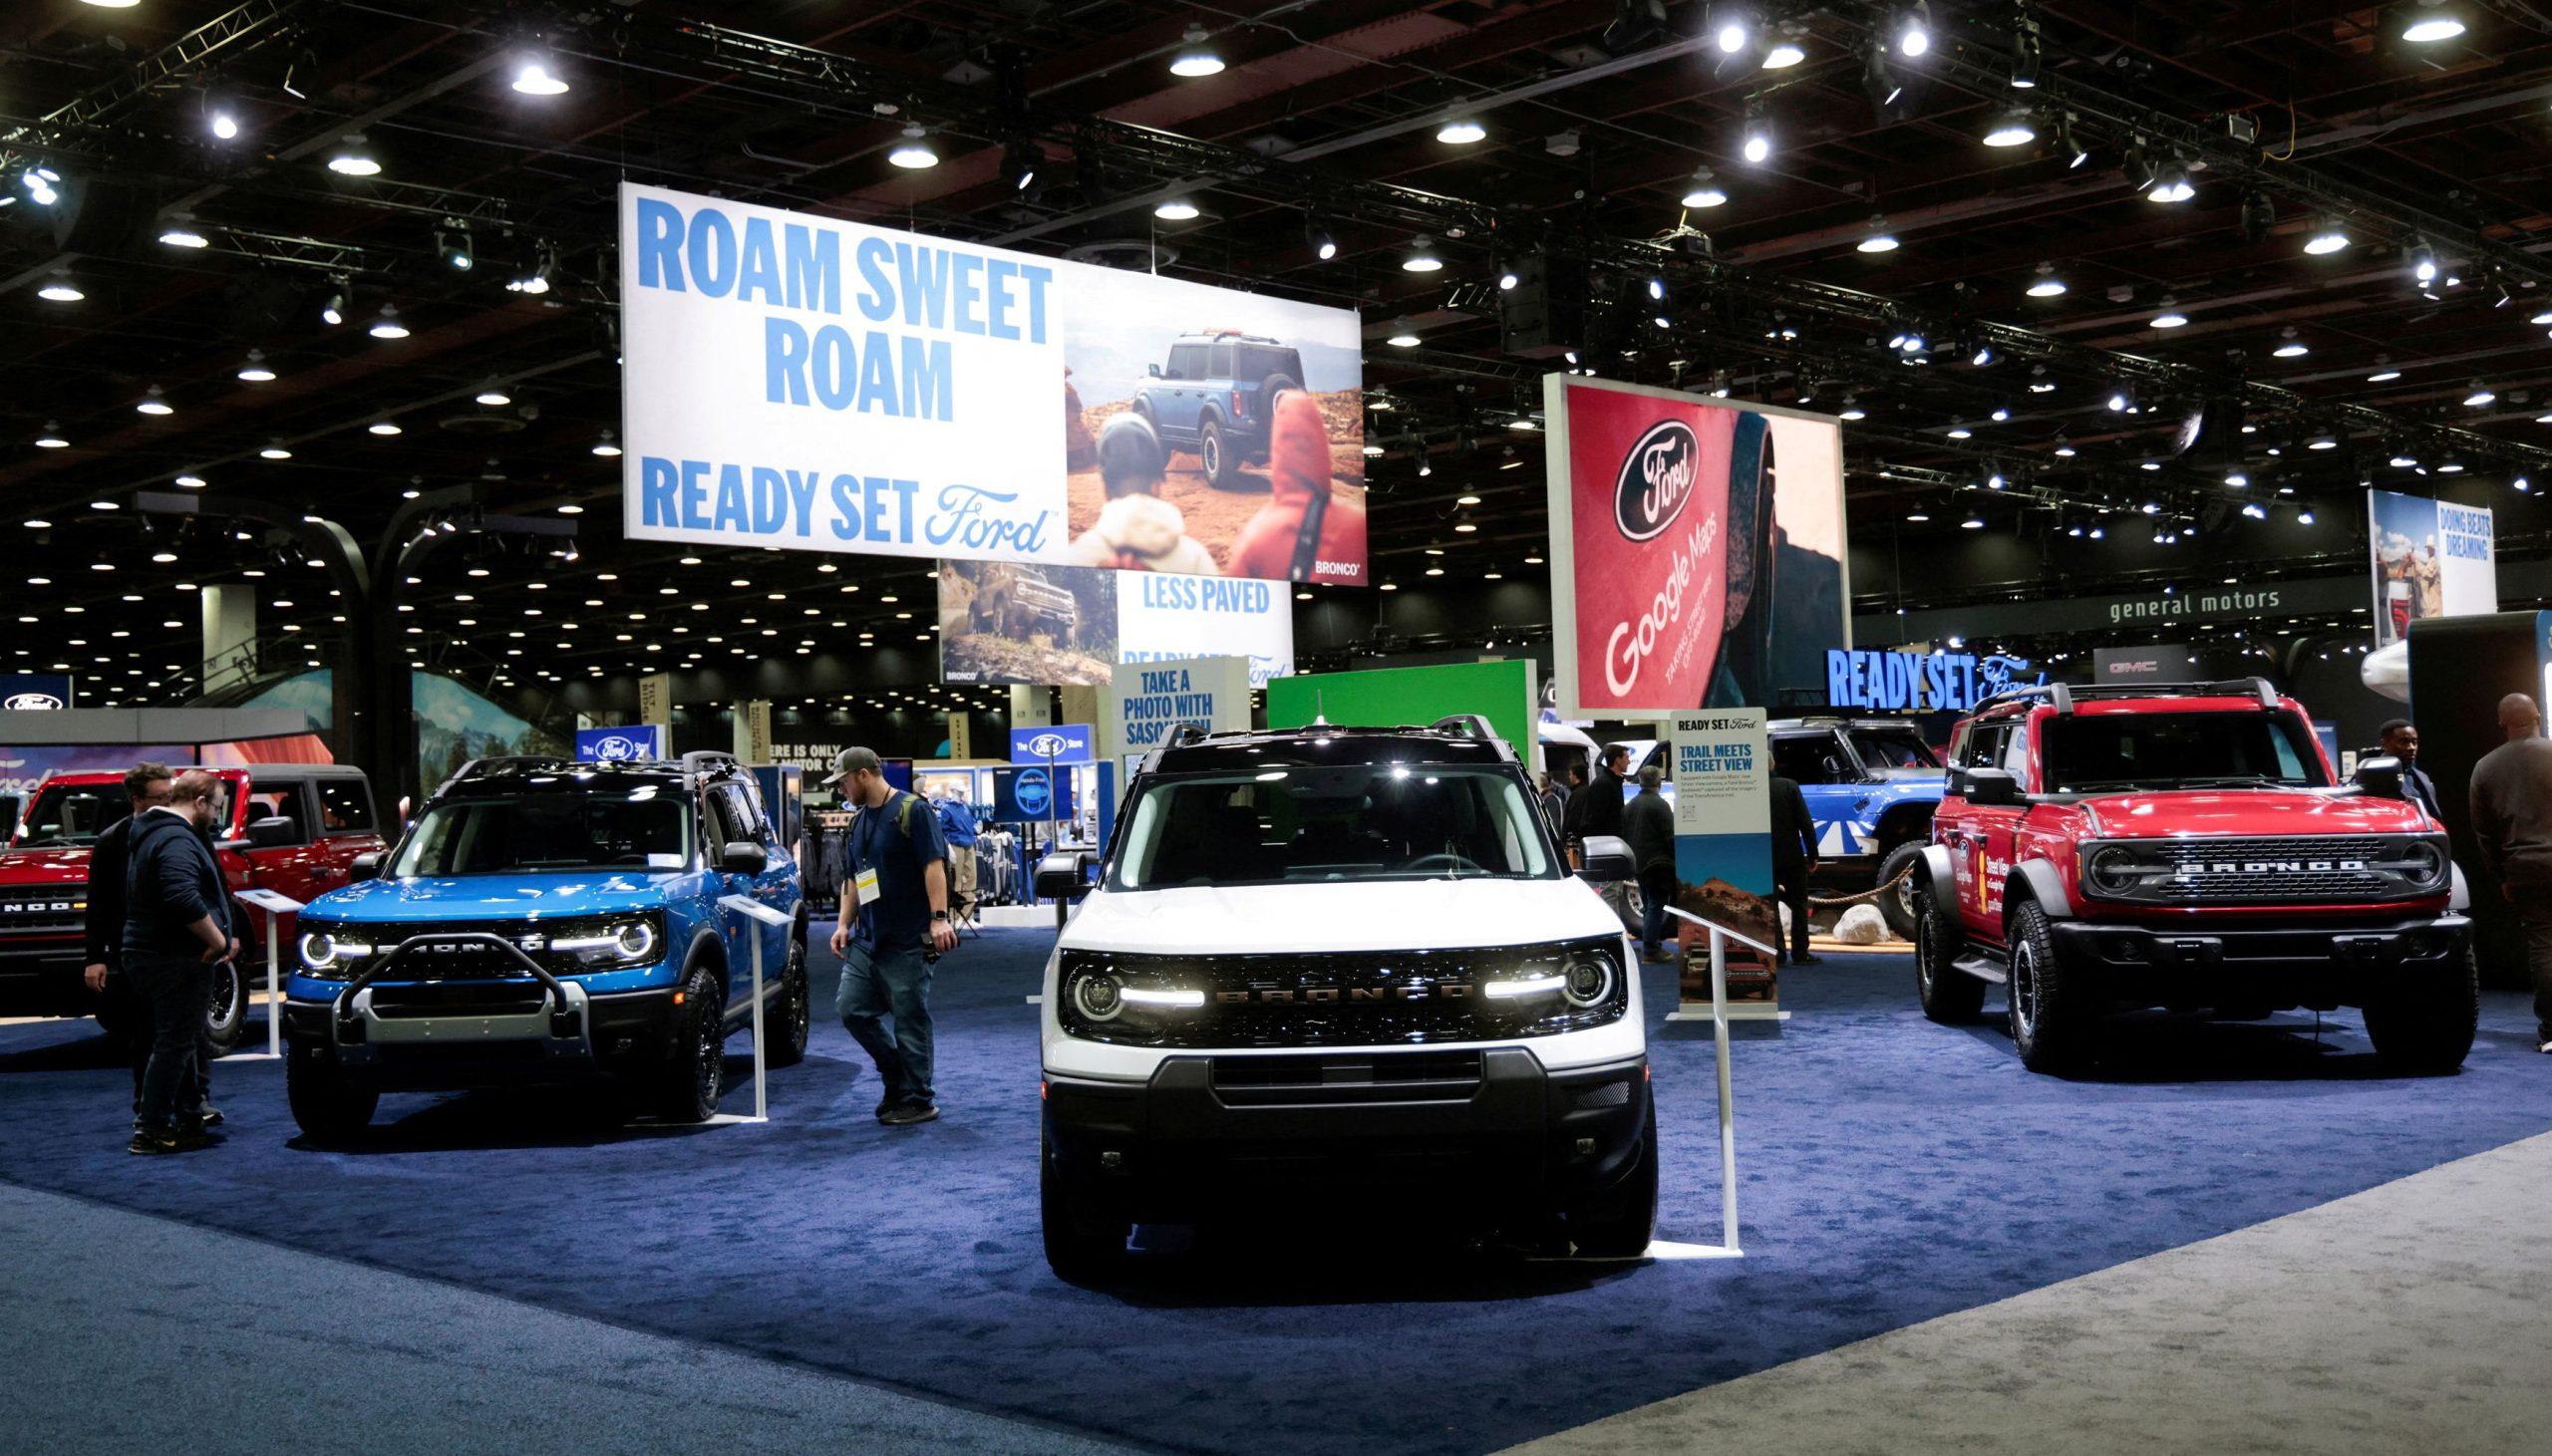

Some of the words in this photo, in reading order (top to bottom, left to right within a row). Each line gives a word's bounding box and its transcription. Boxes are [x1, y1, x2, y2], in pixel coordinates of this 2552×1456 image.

[636, 196, 841, 315] ROAM
[856, 237, 1053, 344] SWEET
[765, 316, 953, 422] ROAM
[1644, 436, 1690, 523] Ford
[642, 456, 819, 537] READY
[830, 473, 919, 544] SET
[925, 483, 1049, 553] Ford
[2440, 508, 2465, 532] DOING
[2466, 512, 2491, 536] BEATS
[2445, 533, 2488, 561] DREAMING
[1143, 575, 1196, 611] LESS
[1202, 579, 1270, 614] PAVED
[1605, 550, 1690, 697] Google
[1688, 511, 1717, 571] Maps
[2110, 595, 2191, 623] general
[2201, 591, 2280, 612] motors
[1827, 650, 1923, 711] READY
[1926, 653, 1977, 711] SET
[2109, 660, 2158, 674] GMC
[1140, 670, 1177, 695] TAKE
[1180, 669, 1191, 692] A
[1123, 695, 1172, 720] PHOTO
[1175, 693, 1213, 718] WITH
[1678, 720, 1710, 730] READY
[1712, 719, 1730, 729] SET
[1730, 719, 1756, 728] Ford
[582, 745, 594, 755] The
[602, 739, 626, 757] Ford
[794, 744, 806, 757] IS
[809, 744, 841, 757] ONLY
[1017, 741, 1028, 751] The
[1036, 737, 1060, 753] Ford
[1068, 738, 1083, 748] Store
[1680, 745, 1712, 758] TRAIL
[1715, 743, 1752, 757] MEETS
[1680, 758, 1722, 772] STREET
[1725, 757, 1753, 771] VIEW
[2181, 861, 2363, 873] BRONCO
[1216, 985, 1473, 1002] BRONCO
